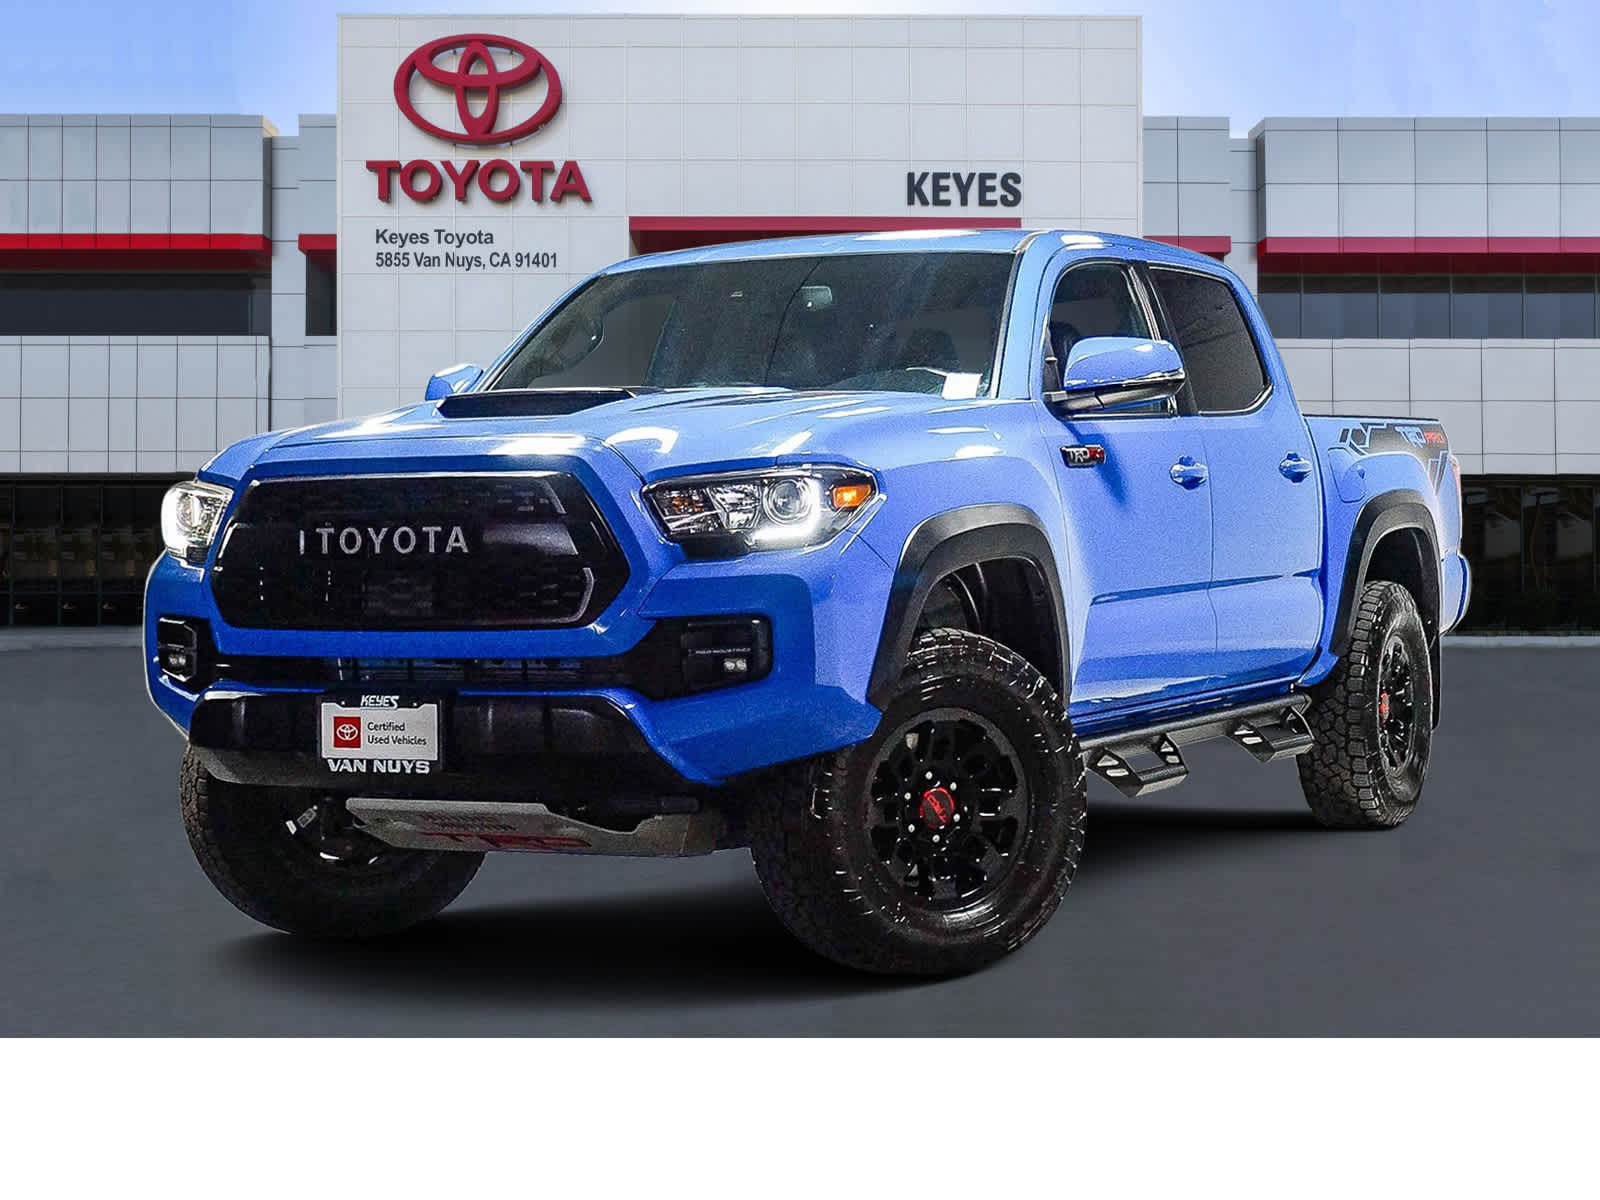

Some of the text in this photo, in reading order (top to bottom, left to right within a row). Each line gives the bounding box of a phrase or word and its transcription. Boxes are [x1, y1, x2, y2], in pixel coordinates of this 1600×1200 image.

[366, 159, 592, 202] TOYOTA
[907, 171, 1022, 207] KEYES
[375, 229, 494, 248] Keyes Toyota
[375, 252, 558, 270] 5855 Van Nuys, CA 91401
[316, 526, 469, 555] TOYOTA
[360, 694, 400, 709] KEYES
[367, 721, 406, 732] Certified
[367, 735, 427, 746] Used Vehicles
[327, 759, 431, 774] VAN NUYS
